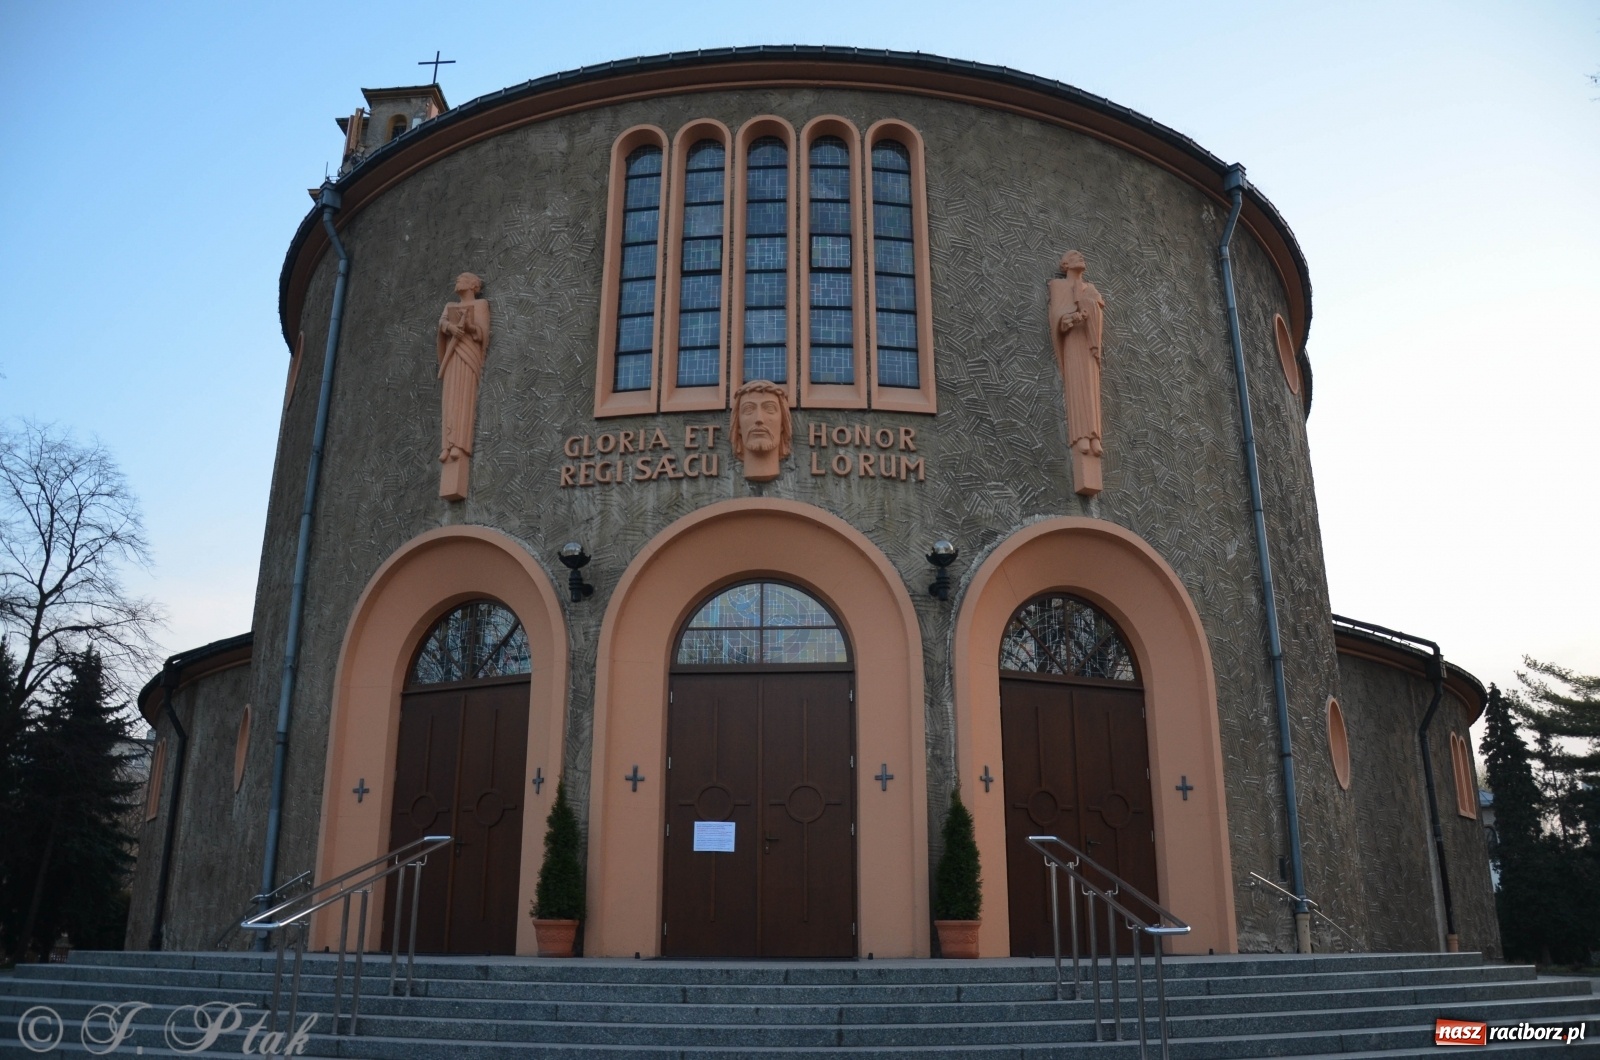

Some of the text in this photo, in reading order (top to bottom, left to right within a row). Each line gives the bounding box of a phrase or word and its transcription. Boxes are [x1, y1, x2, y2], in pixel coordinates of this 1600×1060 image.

[564, 422, 917, 457] GLORIA ET HONOR
[560, 461, 623, 487] REGI
[810, 452, 926, 480] LORUM
